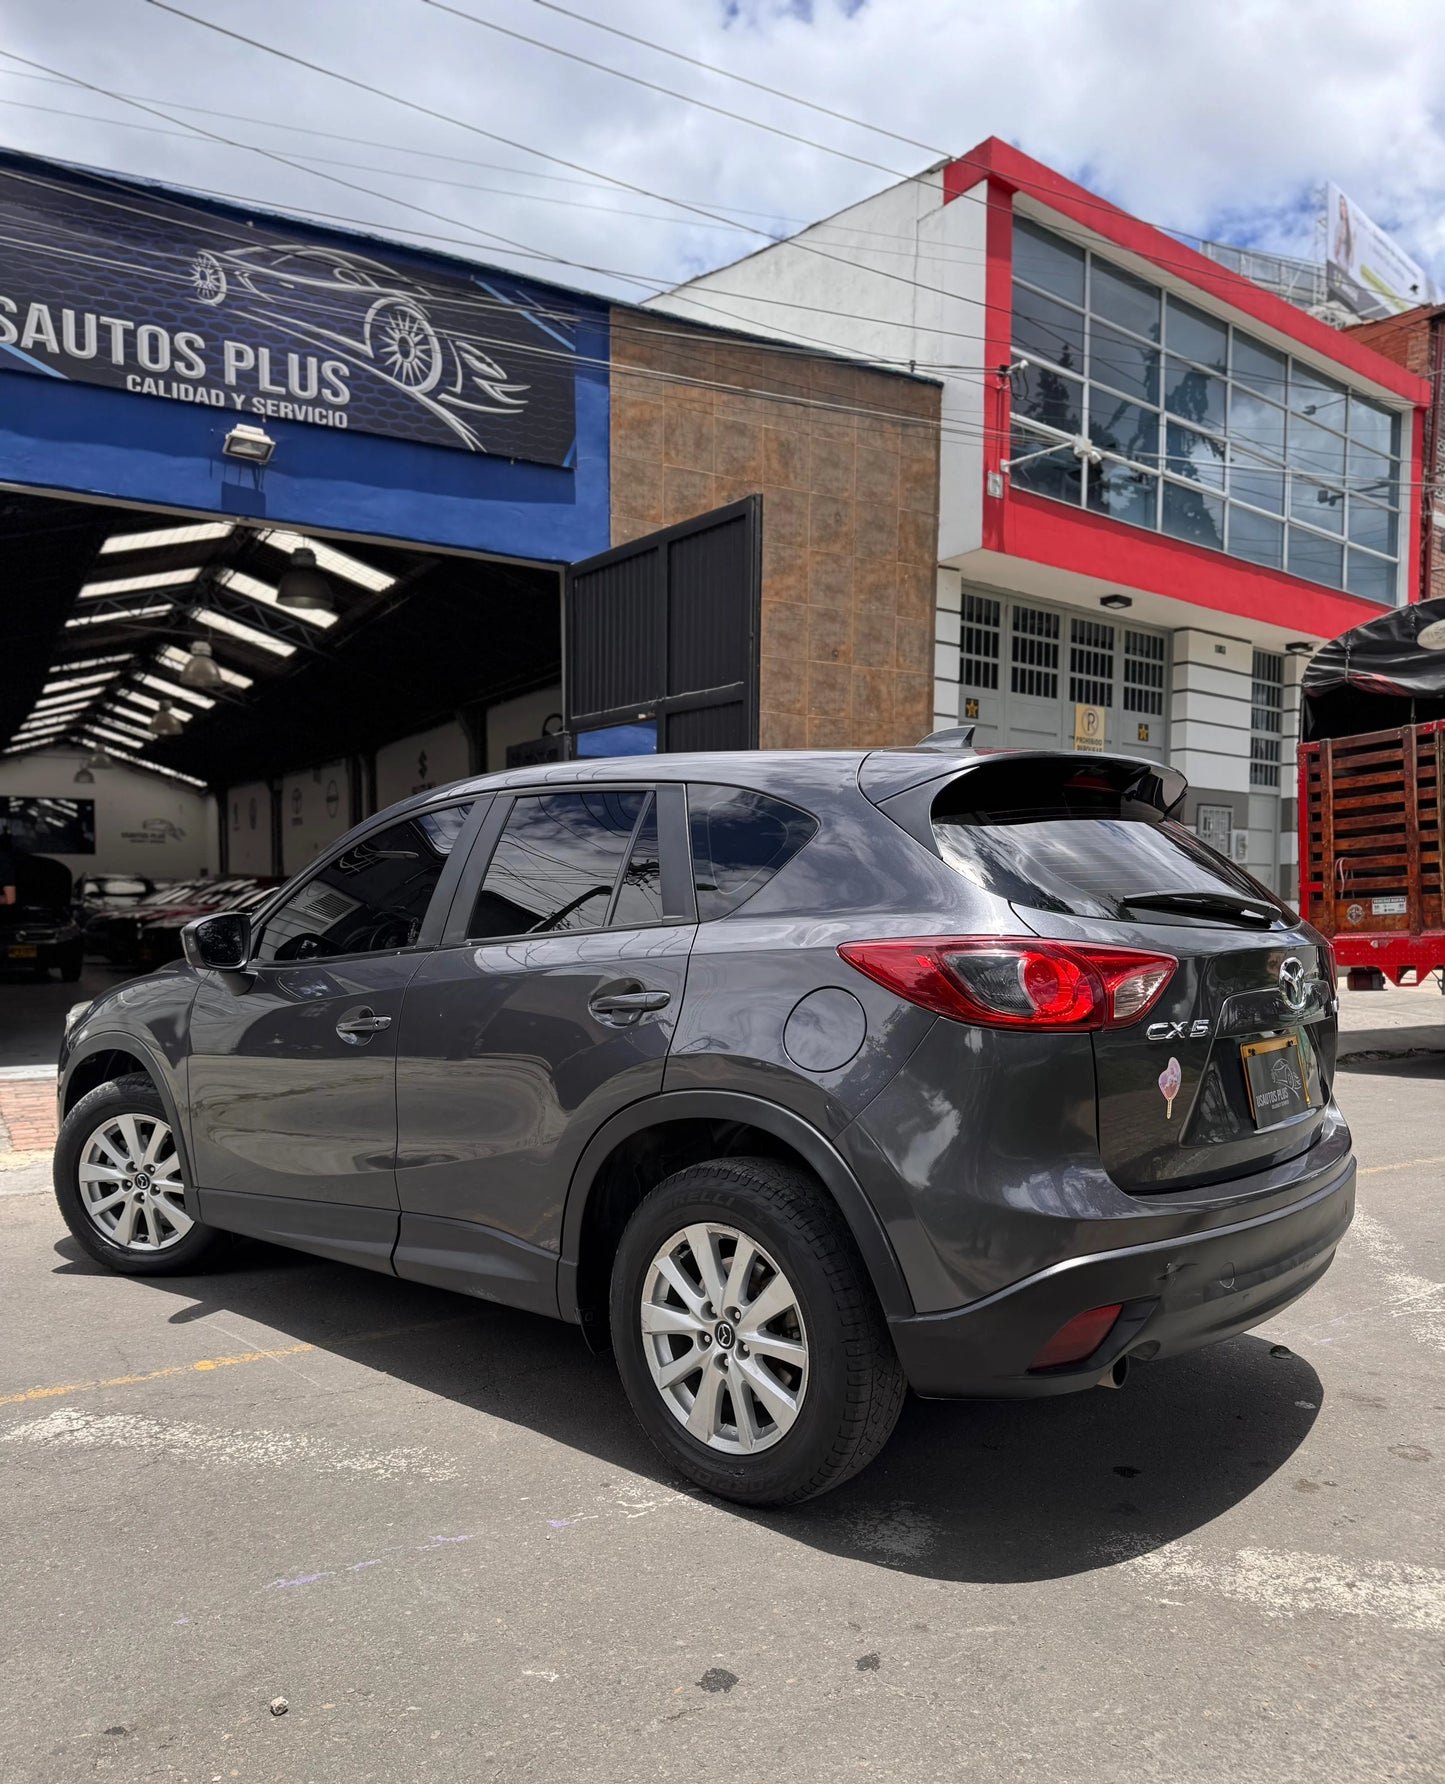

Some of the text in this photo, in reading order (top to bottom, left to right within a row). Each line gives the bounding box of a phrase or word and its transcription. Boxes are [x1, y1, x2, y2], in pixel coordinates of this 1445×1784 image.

[224, 340, 351, 406] PLUS
[126, 375, 348, 429] CALIDAD Y SERVICIO
[1277, 1087, 1289, 1101] PLUS
